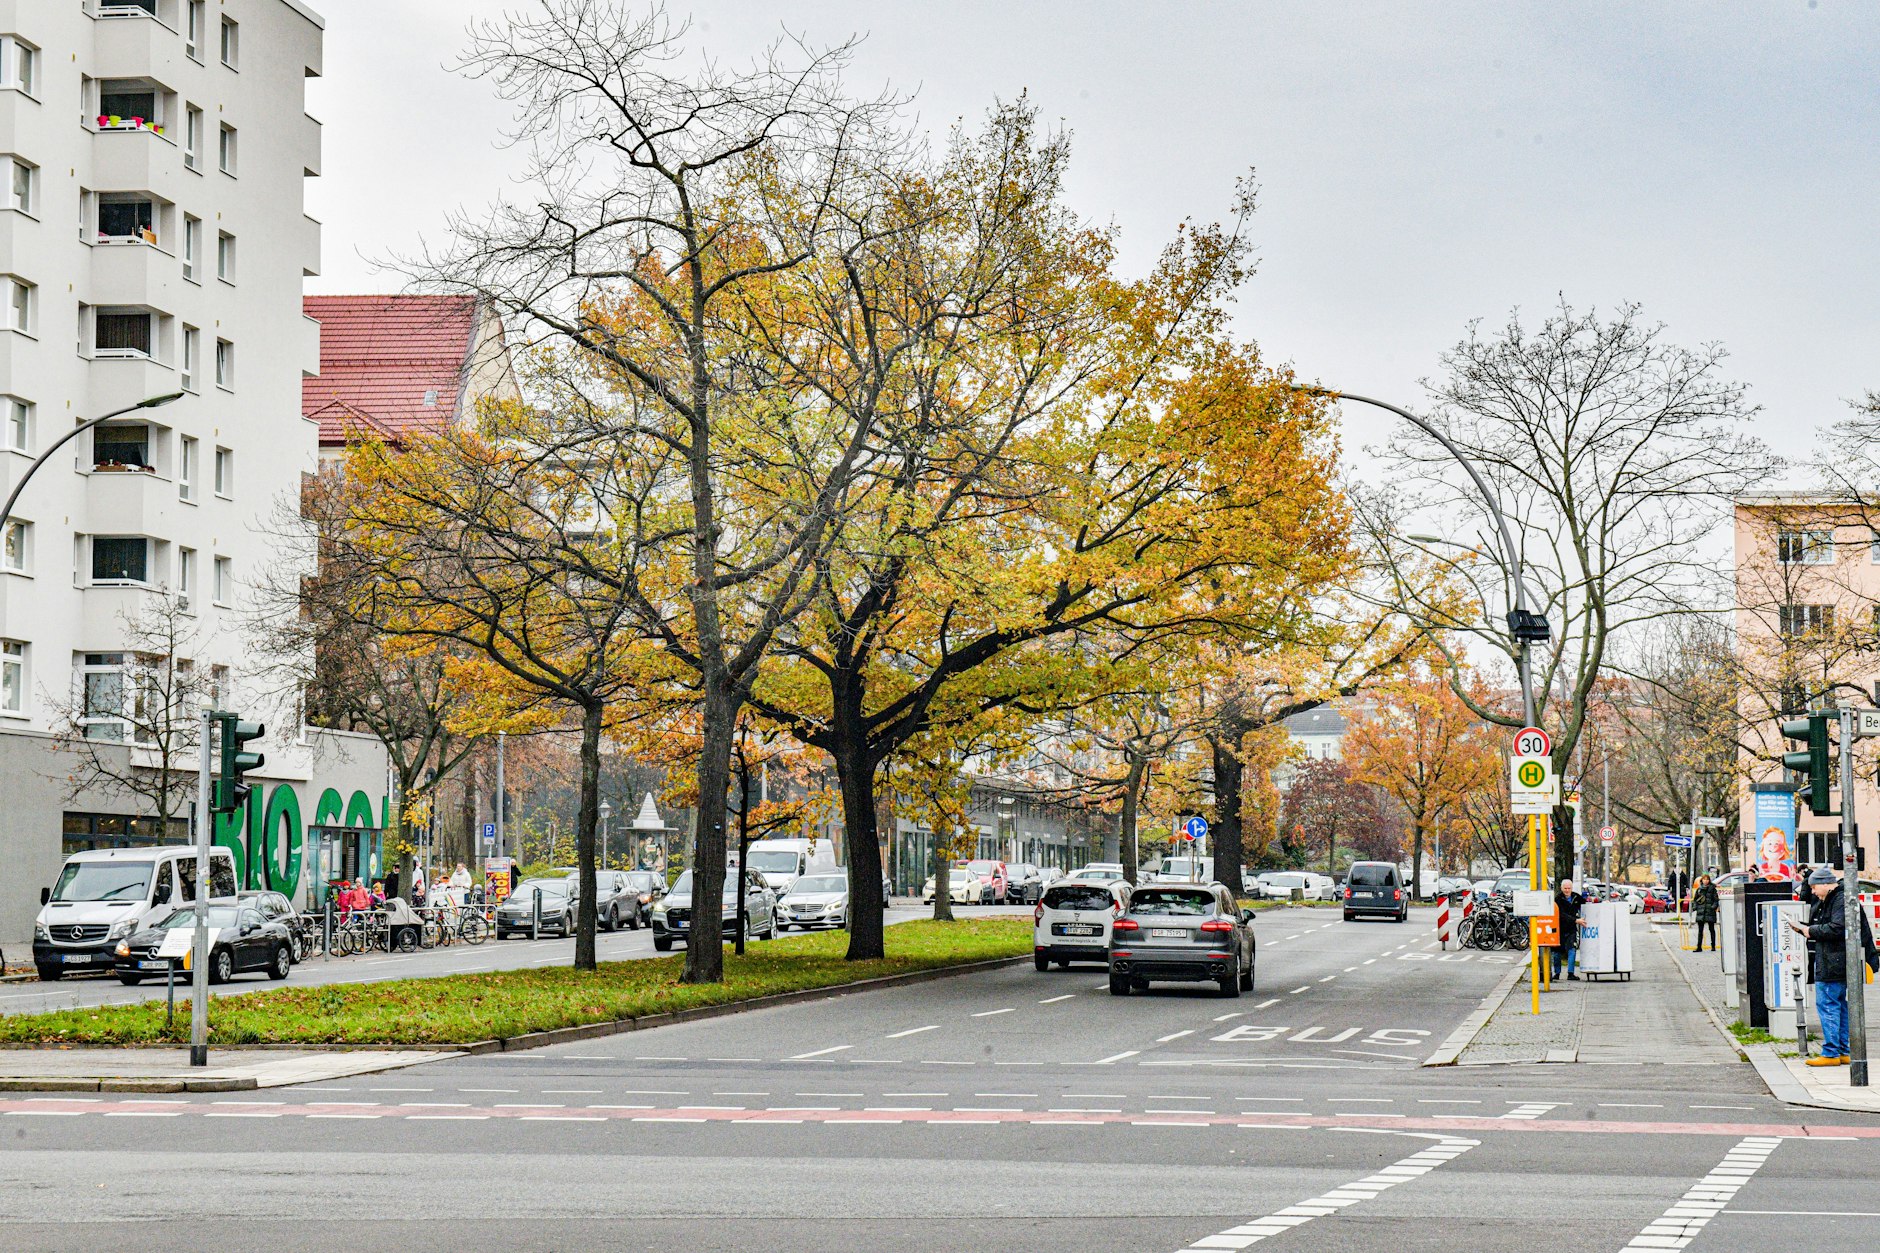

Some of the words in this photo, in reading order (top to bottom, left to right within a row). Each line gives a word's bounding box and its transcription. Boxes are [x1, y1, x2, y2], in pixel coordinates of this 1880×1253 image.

[1866, 716, 1880, 727] Be
[1522, 738, 1542, 753] 30
[1525, 767, 1538, 782] H
[486, 826, 493, 836] P
[212, 780, 302, 901] BIO
[1582, 927, 1599, 939] KOGA
[1396, 952, 1514, 964] BUS
[1209, 1024, 1432, 1046] BUS
